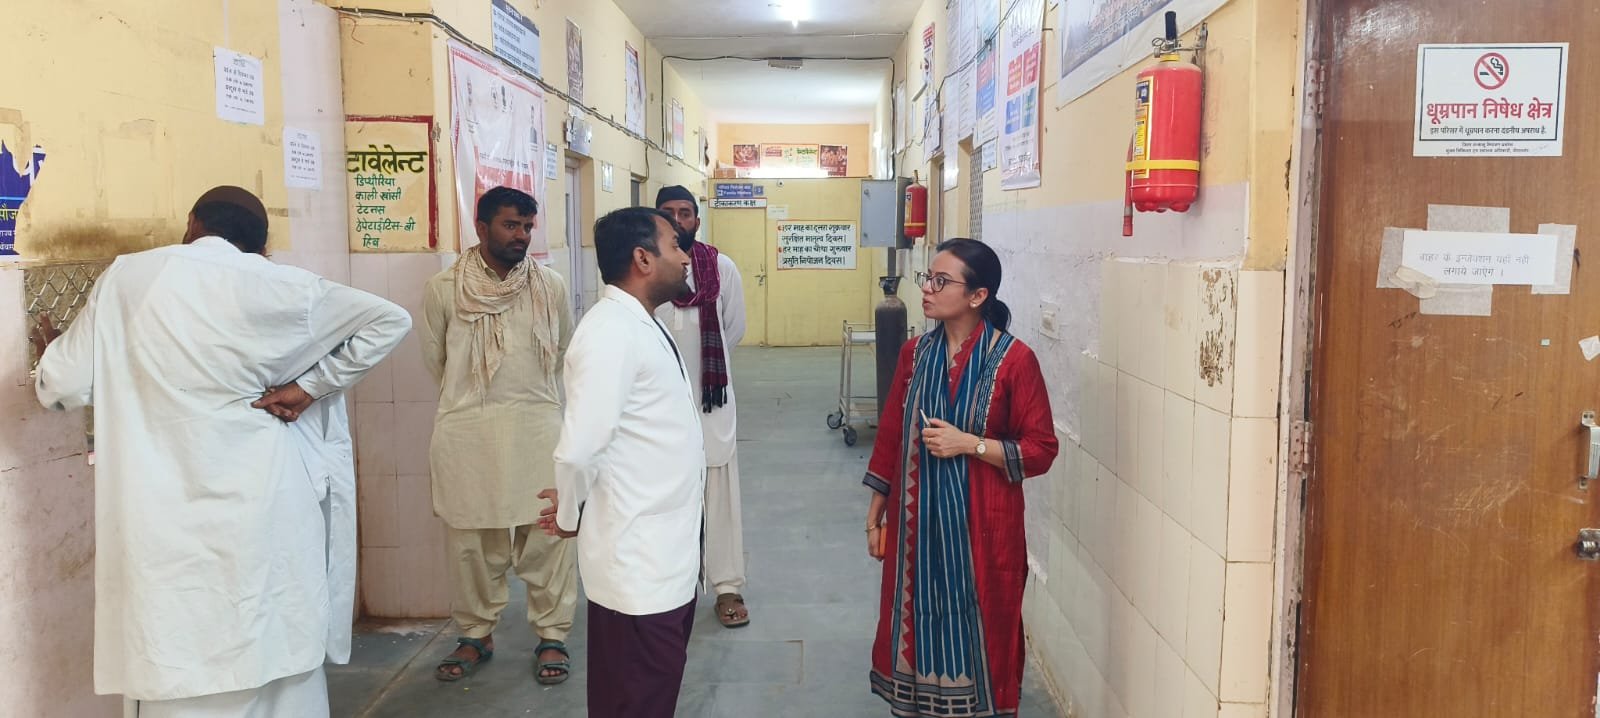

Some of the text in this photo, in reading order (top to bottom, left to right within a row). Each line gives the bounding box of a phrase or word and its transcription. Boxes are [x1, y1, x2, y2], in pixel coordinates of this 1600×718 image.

[1426, 98, 1553, 124] धूम्रपान निषेध क्षेत्र
[355, 188, 378, 200] काली
